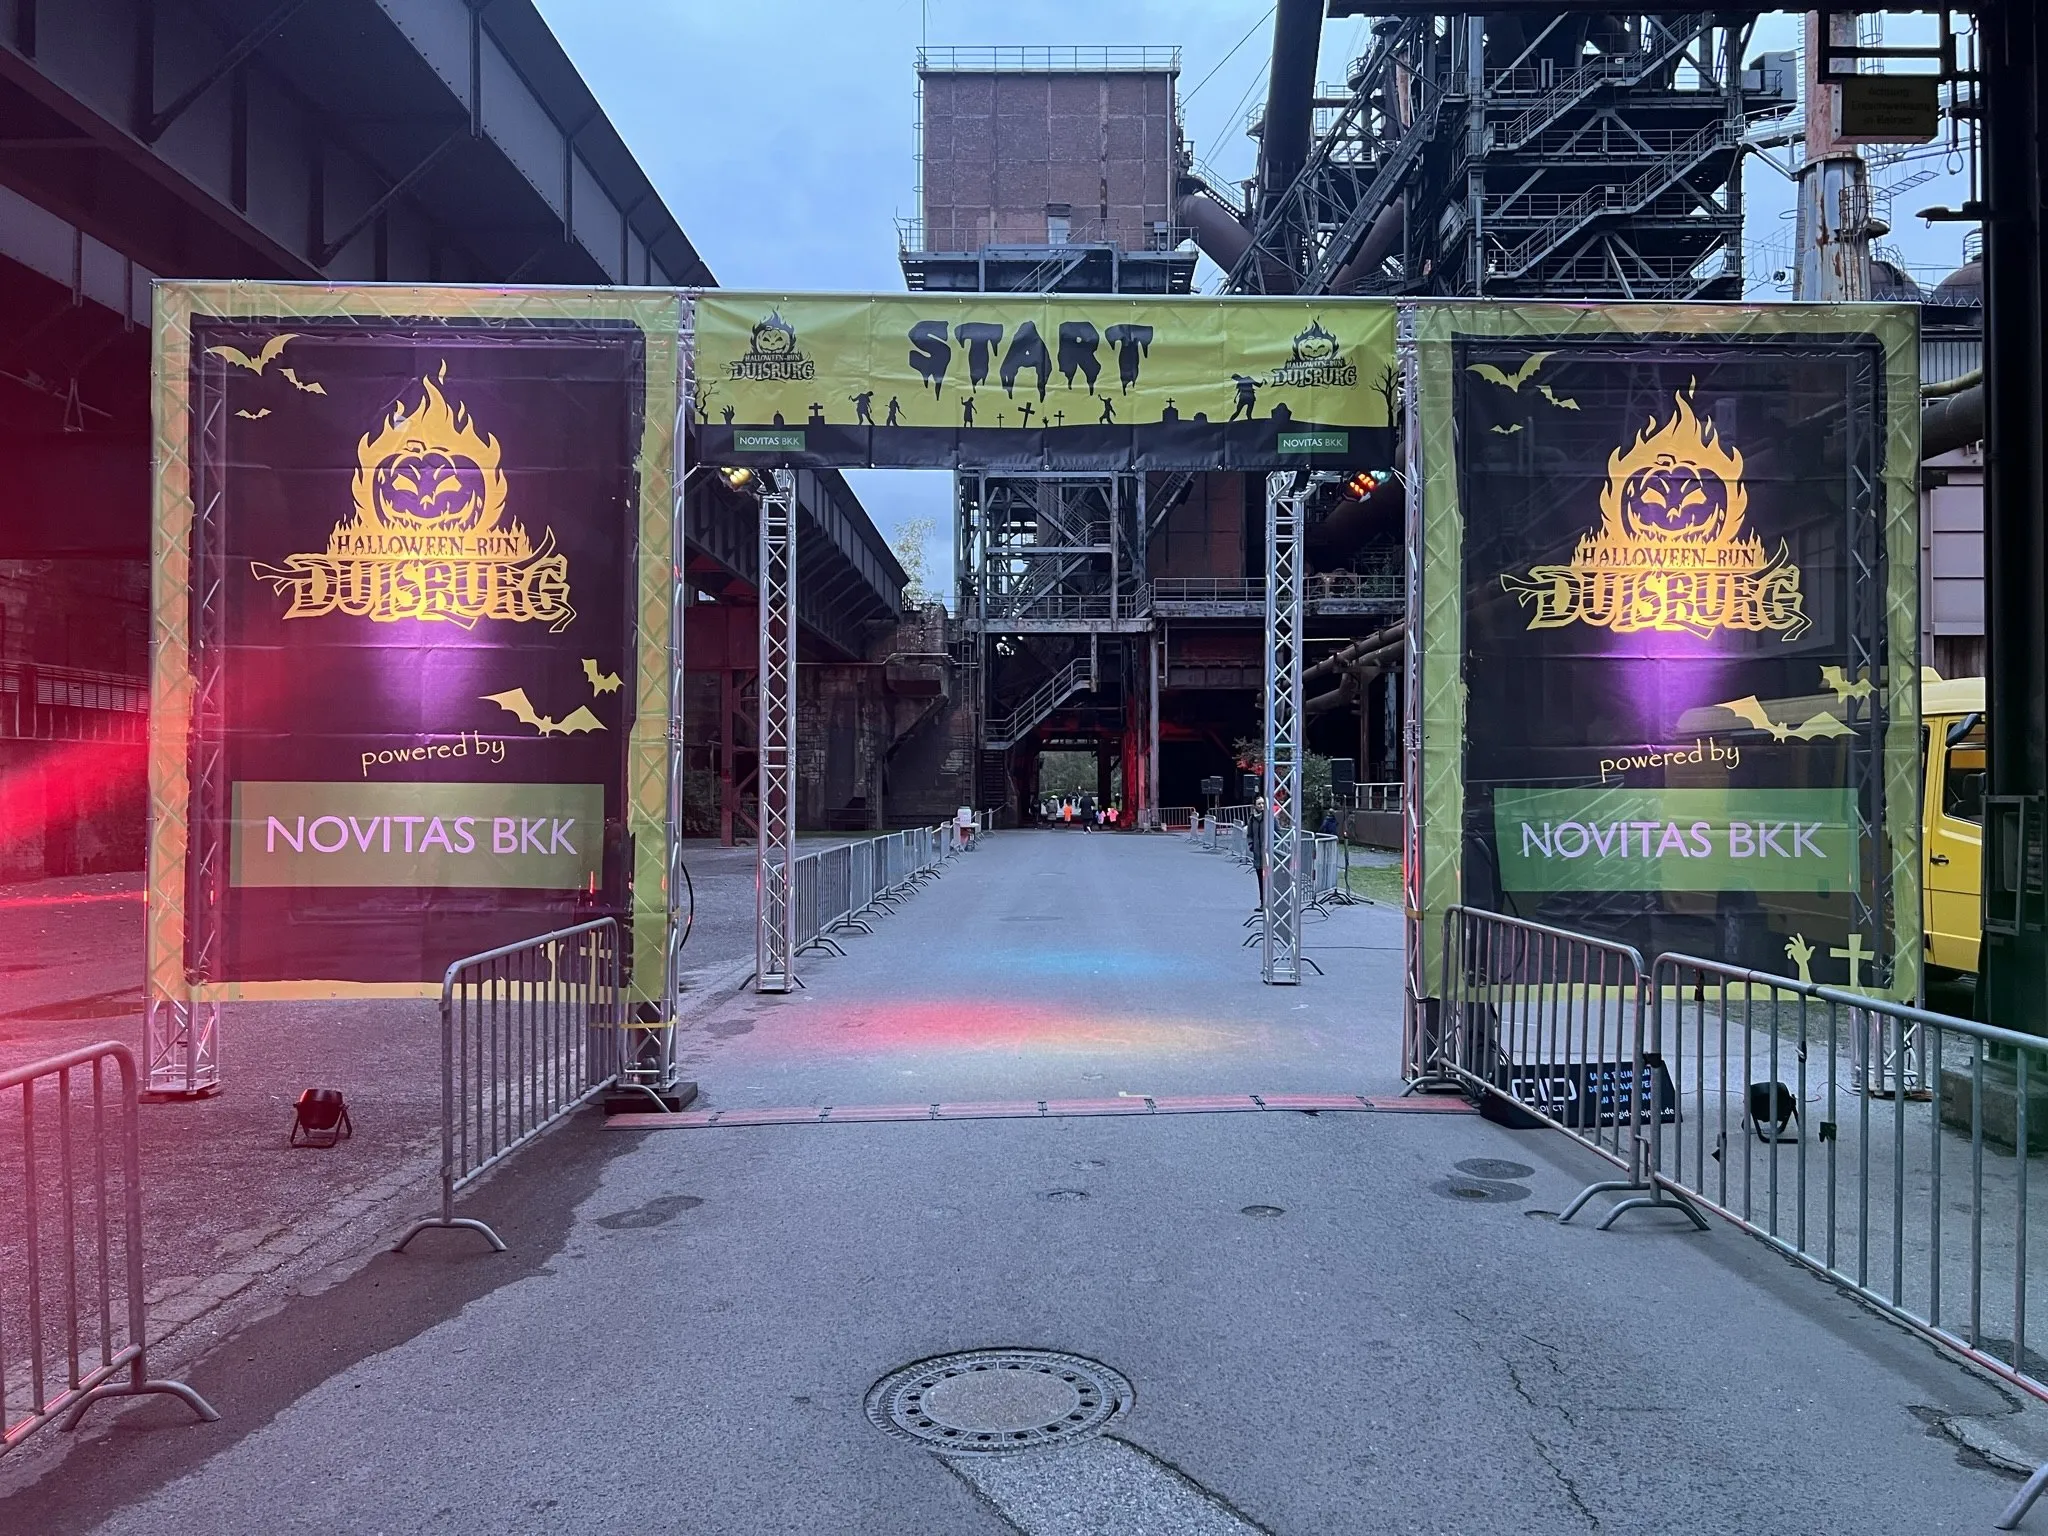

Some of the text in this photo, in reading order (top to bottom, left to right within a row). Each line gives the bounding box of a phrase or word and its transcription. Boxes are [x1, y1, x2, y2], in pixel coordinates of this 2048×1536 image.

[745, 353, 801, 361] HALLOWEEN-RUN
[908, 320, 1153, 403] START
[1286, 360, 1344, 369] HALLOWEEN-RUN
[730, 360, 815, 382] DUISBURG
[1272, 368, 1358, 387] DUISBURG
[739, 436, 800, 446] NOVITAS BKK
[1283, 438, 1343, 448] NOVITAS BKK
[336, 535, 520, 557] HALLOWEEN-RUN
[1582, 547, 1756, 568] HALLOWEEN-RUN
[283, 553, 569, 622] DUISBURG
[1526, 565, 1803, 632] DUISBURG
[361, 730, 506, 777] powered by
[1600, 737, 1740, 783] powered by
[267, 815, 577, 855] NOVITAS BKK
[1521, 821, 1827, 858] NOVITAS BKK
